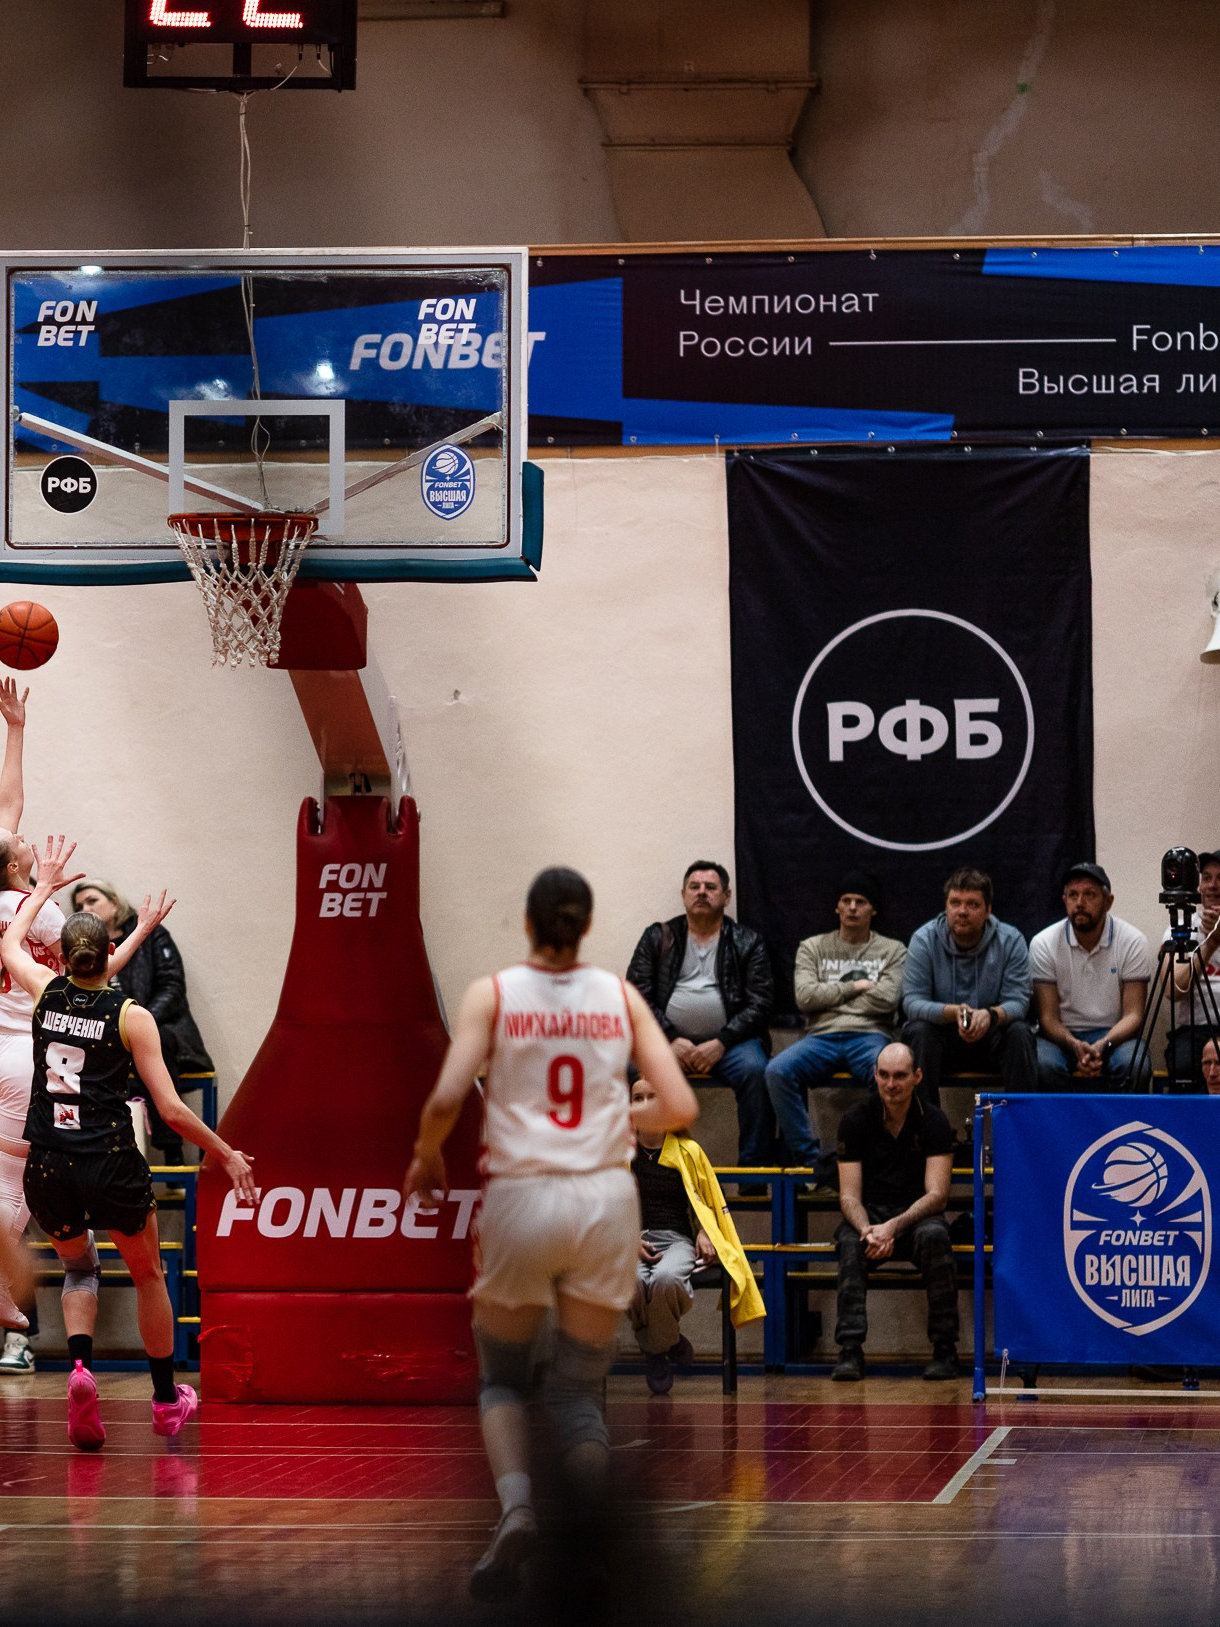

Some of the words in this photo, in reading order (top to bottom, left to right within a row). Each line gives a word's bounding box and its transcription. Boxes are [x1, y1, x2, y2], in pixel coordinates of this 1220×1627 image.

[37, 300, 98, 322] FON
[417, 298, 477, 320] FON
[680, 289, 880, 315] Чемпионат
[37, 325, 95, 346] BET
[418, 323, 476, 345] BET
[680, 331, 812, 357] России
[1133, 322, 1219, 351] Fonb
[1019, 368, 1160, 395] Высшая
[1176, 374, 1217, 393] ли
[47, 476, 91, 493] РФБ
[429, 490, 467, 502] ВЫСШАЯ
[826, 697, 1004, 762] РФБ
[318, 863, 388, 889] FON
[318, 892, 388, 918] BET
[41, 1010, 106, 1041] ШЕВЧЕНКО
[505, 1008, 624, 1041] МИХАЙЛОВА
[45, 1041, 86, 1094] 8
[548, 1054, 584, 1130] 9
[216, 1186, 482, 1239] FONBET
[1098, 1230, 1179, 1246] FONBET
[1085, 1254, 1191, 1286] ВЫСШАЯ
[1121, 1289, 1155, 1307] ЛИГА
